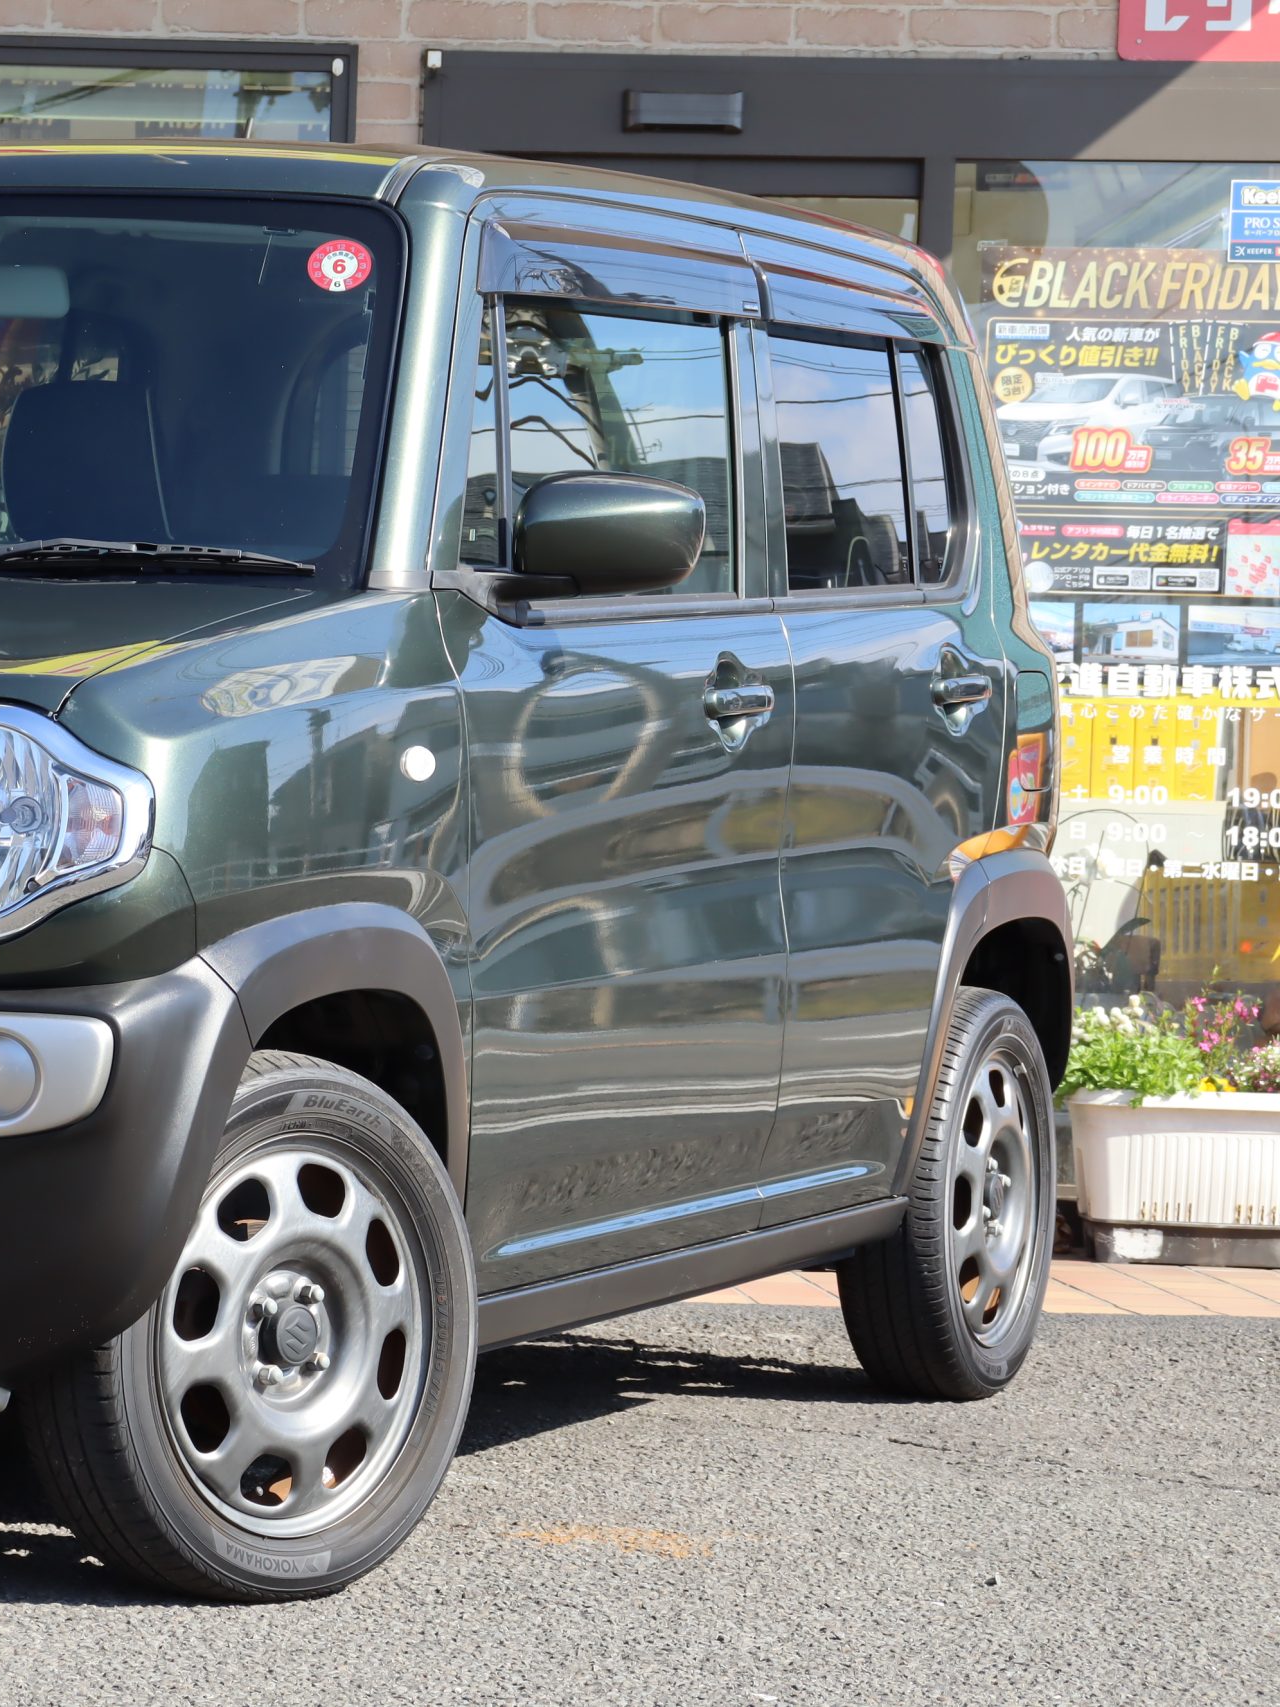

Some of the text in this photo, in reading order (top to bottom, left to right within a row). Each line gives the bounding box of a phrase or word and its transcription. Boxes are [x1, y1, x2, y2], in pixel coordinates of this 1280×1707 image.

[1242, 188, 1280, 205] Kee
[1244, 217, 1270, 229] PRO
[332, 259, 346, 274] 6
[1024, 260, 1157, 309] BLACK
[1066, 326, 1161, 343] 人気の新車が
[995, 344, 1159, 368] びっくり値引き!!
[1179, 325, 1190, 393] FRIDAY
[1191, 325, 1204, 388] BLACK
[1211, 326, 1225, 393] FRIDAY
[1222, 328, 1239, 391] BLACK
[1001, 374, 1024, 386] 限定
[1074, 430, 1148, 467] 100 万円
[1229, 440, 1265, 471] 35
[1009, 470, 1039, 478] の8点
[1011, 483, 1070, 495] ション付き
[1030, 541, 1219, 564] レンタカー代金無料!
[1111, 746, 1226, 766] 営業時間
[1108, 784, 1168, 806] 9:00
[1070, 822, 1087, 840] 日
[1107, 822, 1167, 843] 9:00
[303, 1094, 382, 1130] BluEarth
[225, 1541, 299, 1573] YOKOHAMA
